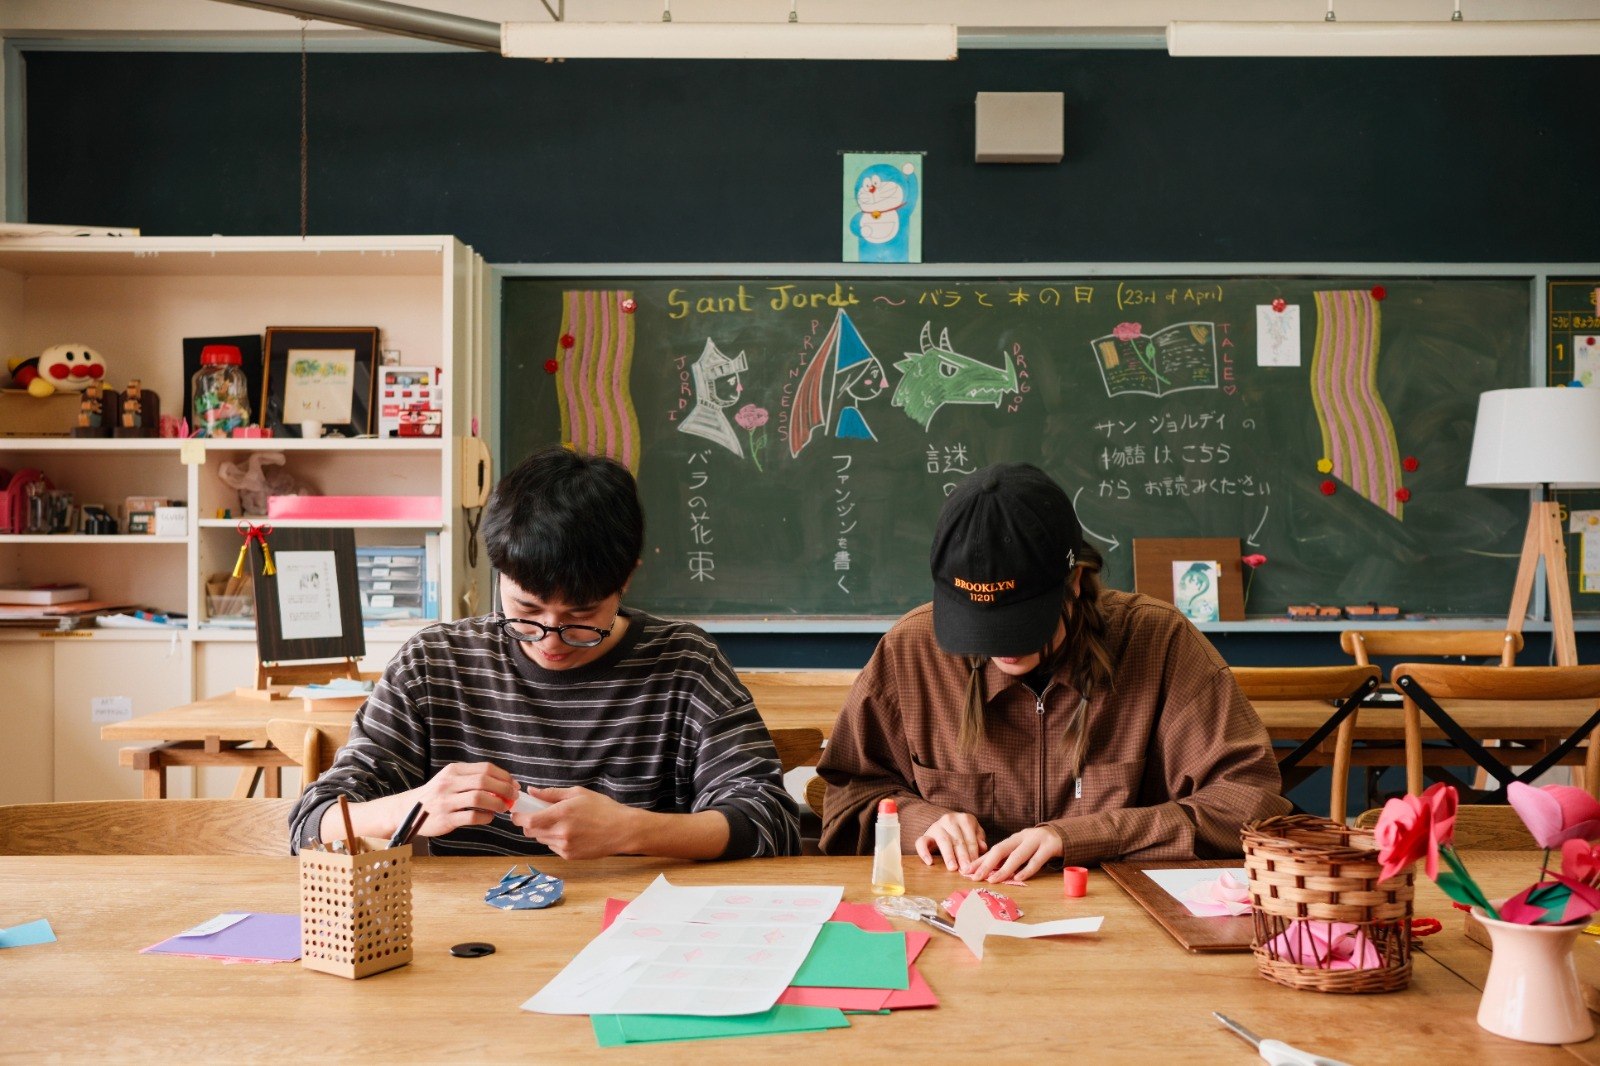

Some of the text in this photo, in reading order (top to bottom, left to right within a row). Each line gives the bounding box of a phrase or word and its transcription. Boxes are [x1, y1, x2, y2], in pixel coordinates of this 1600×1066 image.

[668, 285, 755, 319] Sant
[766, 282, 859, 311] Jordi
[1117, 282, 1156, 310] (23rd
[1165, 288, 1178, 305] of
[778, 319, 819, 441] PRINCESS
[1008, 342, 1031, 413] DRAGON
[1217, 323, 1234, 380] TALE
[1556, 344, 1564, 361] 1
[668, 356, 692, 421] JORDI
[687, 449, 716, 582] バラの花束
[954, 577, 1016, 593] BROOKLYN
[970, 592, 995, 603] 11201
